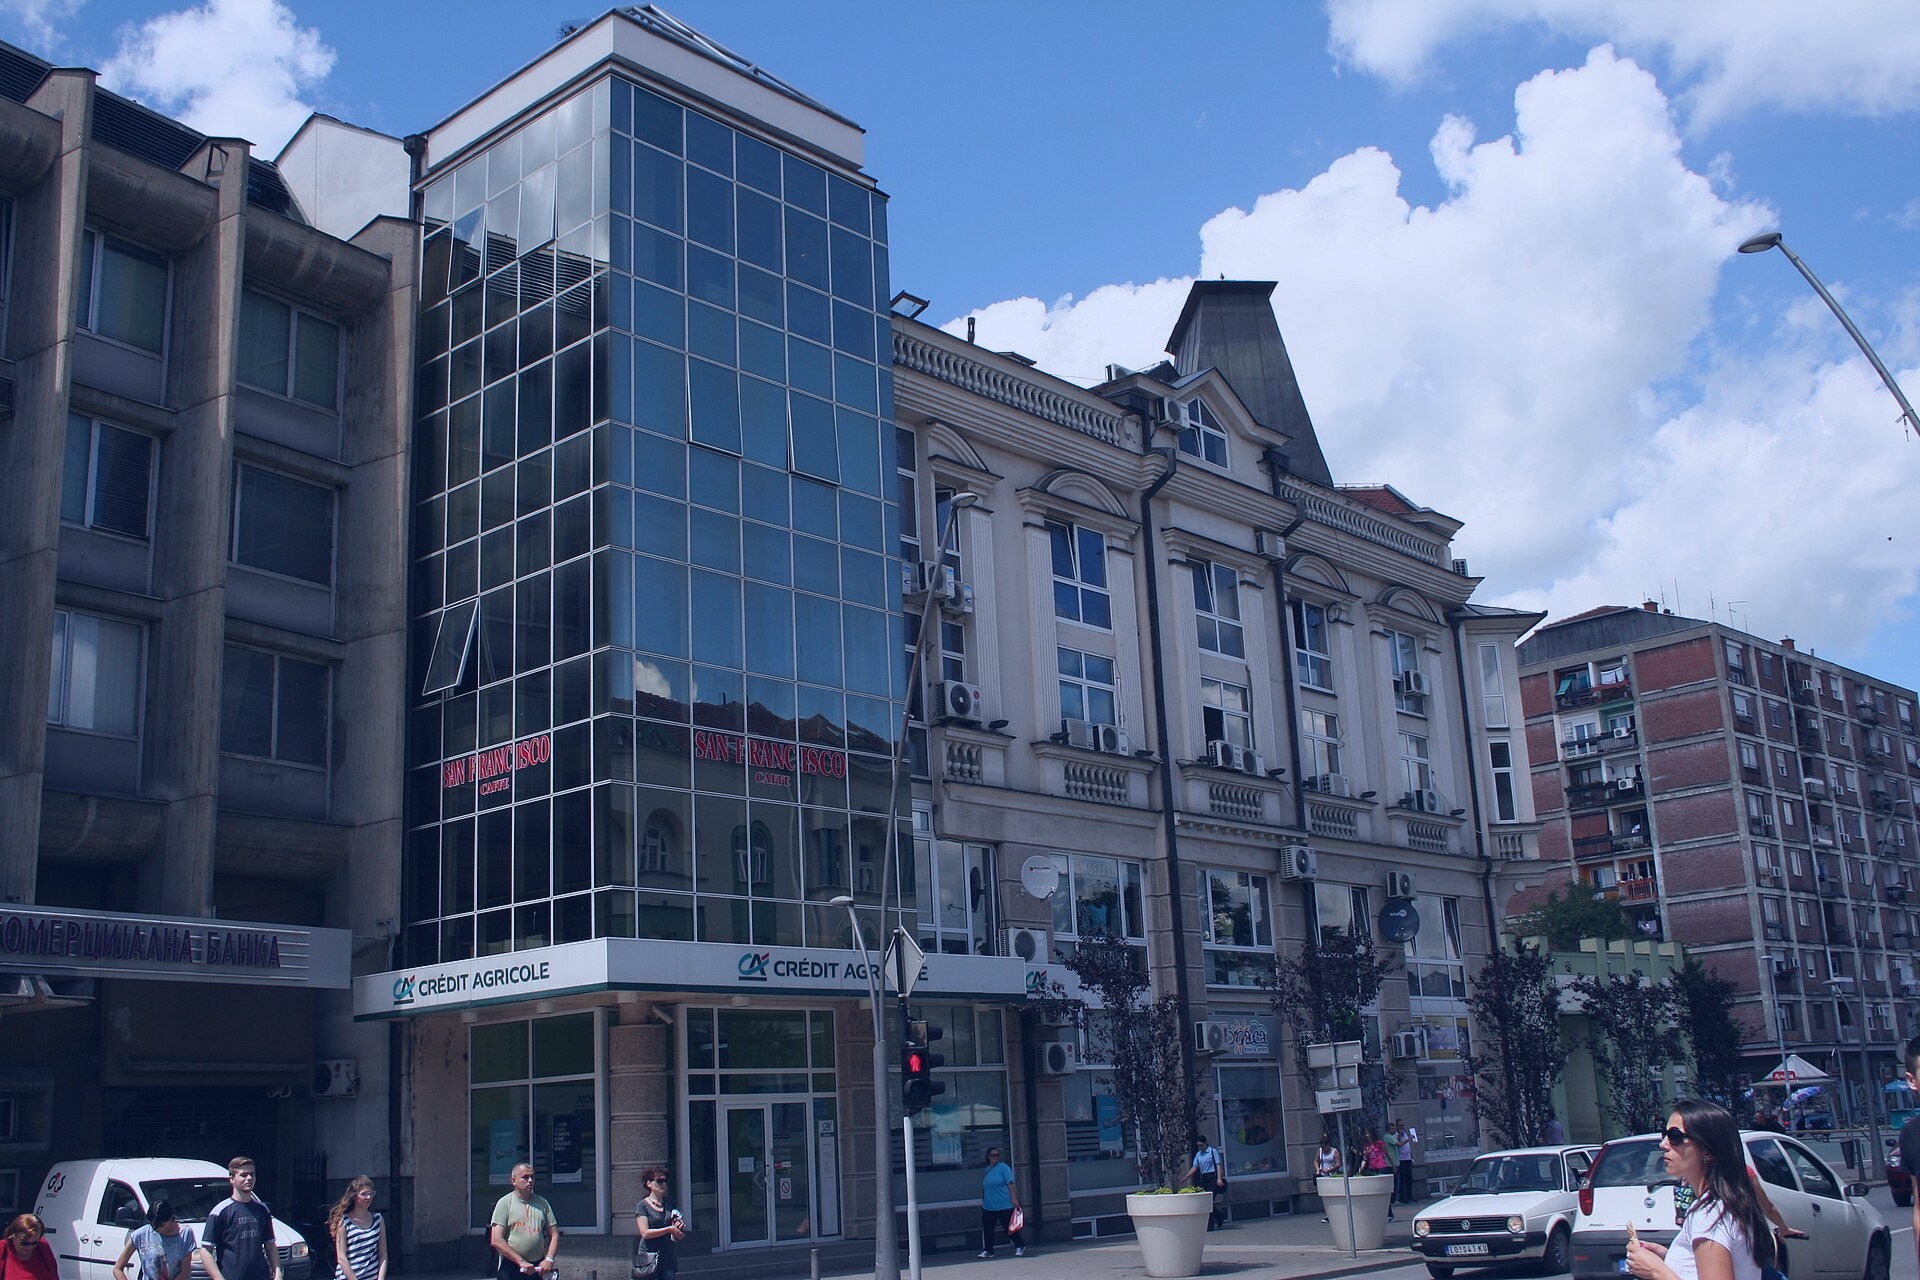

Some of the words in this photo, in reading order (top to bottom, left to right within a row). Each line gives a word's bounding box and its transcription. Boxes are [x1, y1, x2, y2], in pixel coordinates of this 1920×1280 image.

[443, 758, 466, 790] SAN
[468, 734, 551, 783] FRANCISCO
[694, 730, 729, 762] SAN
[734, 737, 846, 779] FRANCISCO
[479, 777, 510, 796] CAFFE
[754, 771, 792, 787] CAFFE
[0, 915, 193, 963] ОМЕРЦИЈАЛНА
[206, 931, 281, 968] БАНКА
[418, 973, 470, 997] CRÉDIT
[472, 961, 550, 990] AGRICOLE
[773, 957, 840, 979] CRÉDIT
